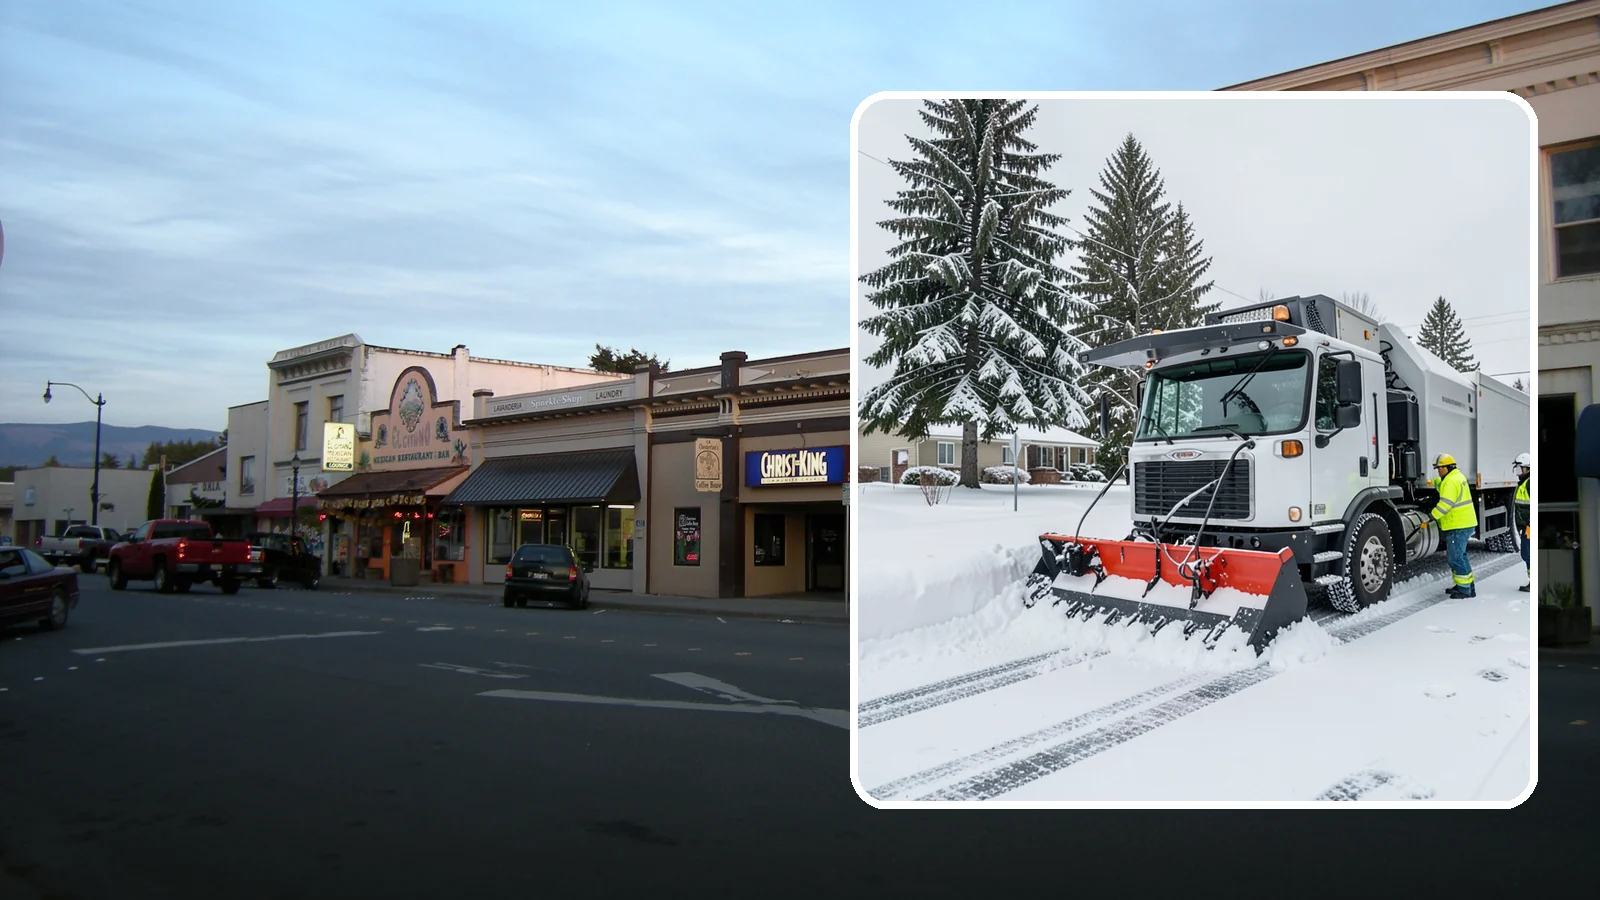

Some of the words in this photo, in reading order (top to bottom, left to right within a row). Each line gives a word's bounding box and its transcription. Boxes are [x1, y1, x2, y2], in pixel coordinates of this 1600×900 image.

[531, 397, 562, 409] Sparkle
[562, 394, 583, 405] Shop
[595, 388, 623, 400] LAUNDRY
[493, 402, 523, 413] LAVANDERIA
[373, 455, 396, 464] MEXICAN
[397, 452, 433, 462] RESTAURANT
[438, 449, 450, 459] BAR
[761, 452, 797, 478] CHRIST
[799, 450, 827, 477] KING
